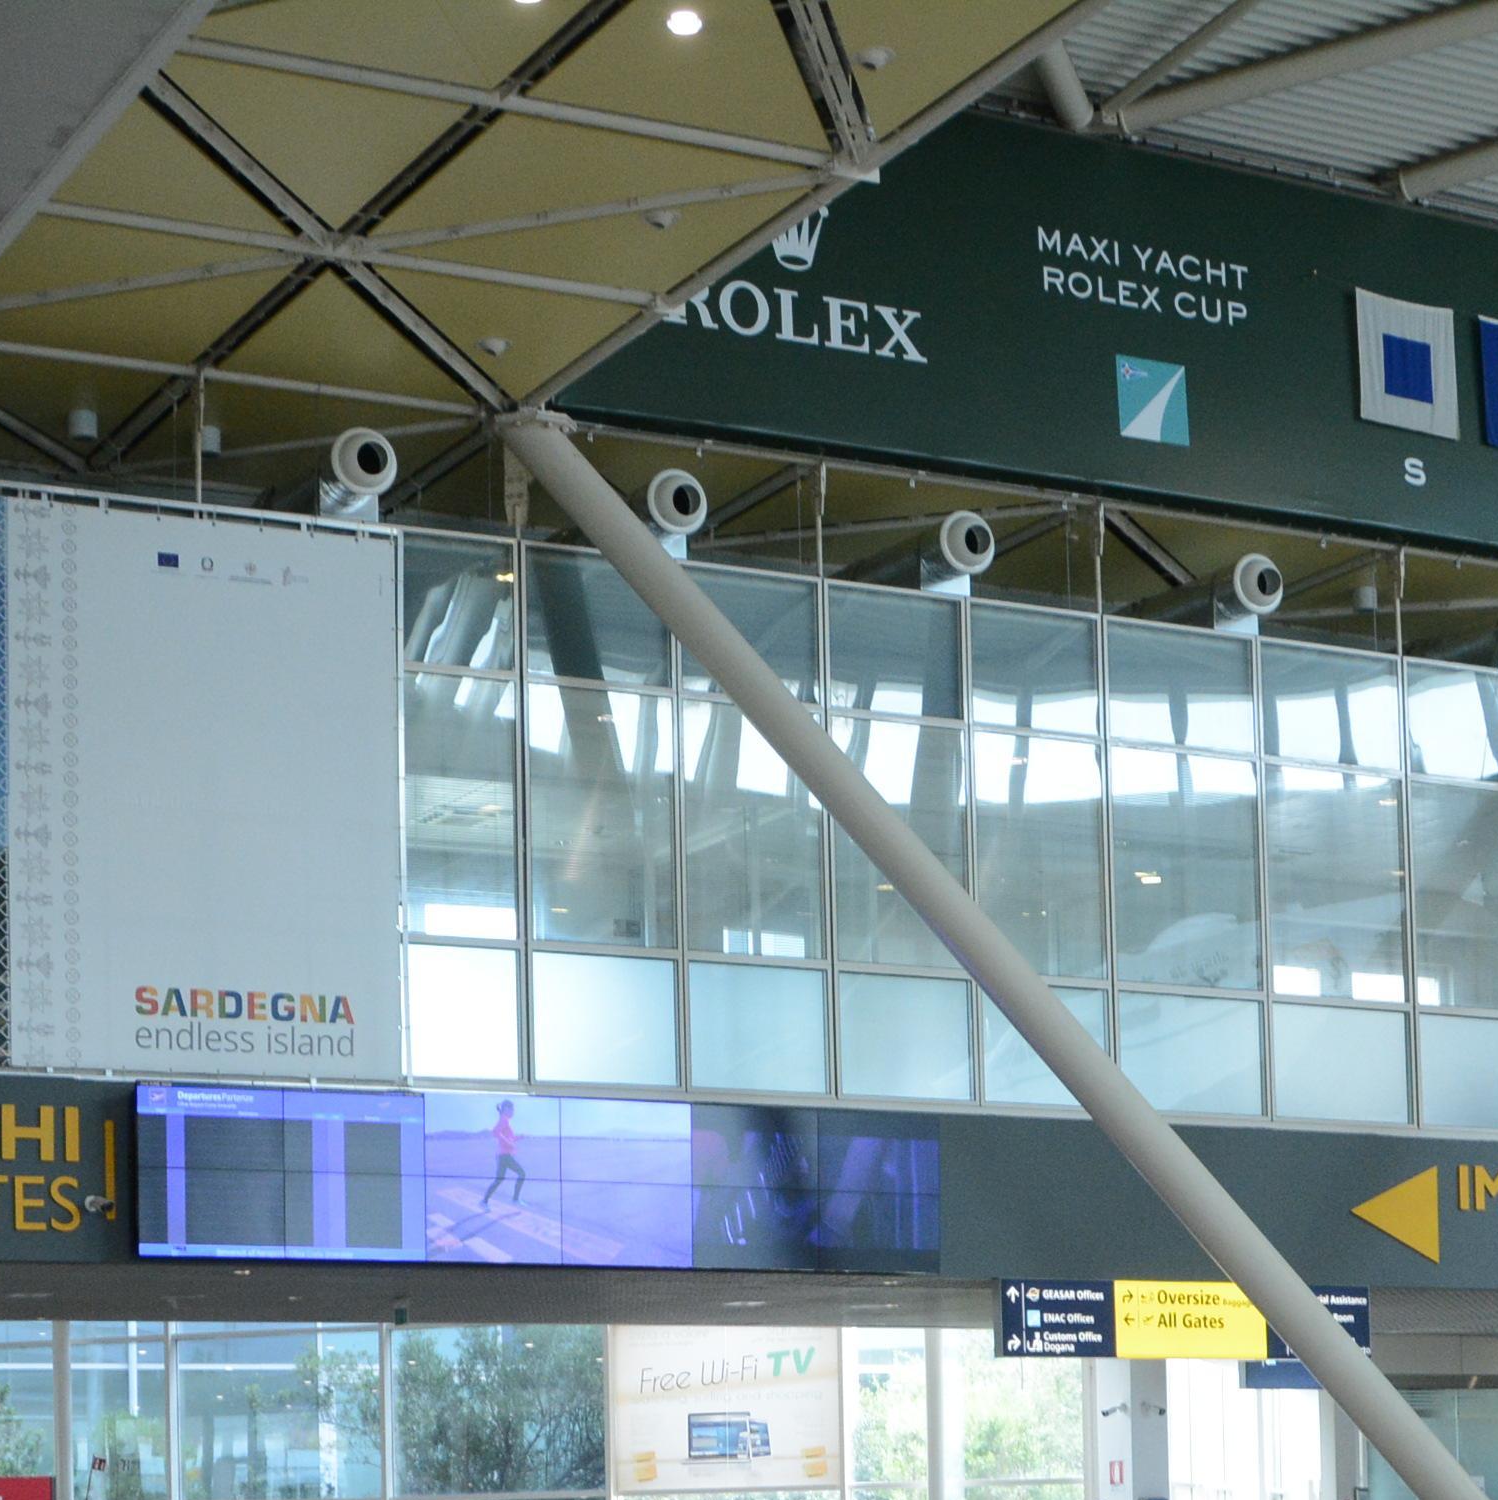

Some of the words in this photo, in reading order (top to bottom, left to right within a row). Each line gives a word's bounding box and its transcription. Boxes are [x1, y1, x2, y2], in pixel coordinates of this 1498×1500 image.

[1037, 226, 1120, 268] MAXI
[1132, 244, 1248, 291] YACHT
[1042, 265, 1162, 314] ROLEX
[1174, 291, 1248, 327] CUP
[662, 279, 929, 365] ROLEX
[134, 984, 356, 1024] SARDEGNA
[134, 1020, 254, 1054] endless
[265, 1023, 356, 1057] island
[177, 1089, 221, 1103] Departures
[222, 1091, 254, 1102] Partenze
[1042, 1289, 1075, 1300] GEASAR
[1076, 1290, 1104, 1301] Offices
[1157, 1289, 1220, 1306] Oversize
[1330, 1294, 1367, 1306] Assistance
[1043, 1313, 1066, 1324] ENAC
[1067, 1313, 1094, 1325] Offices
[1157, 1313, 1177, 1328] All
[1182, 1313, 1224, 1330] Gates
[1043, 1331, 1077, 1343] Customs
[1078, 1331, 1103, 1344] Office
[1044, 1341, 1075, 1354] Dogana
[639, 1367, 691, 1394] Free
[701, 1355, 758, 1387] Wi-Fi
[766, 1346, 816, 1378] TV
